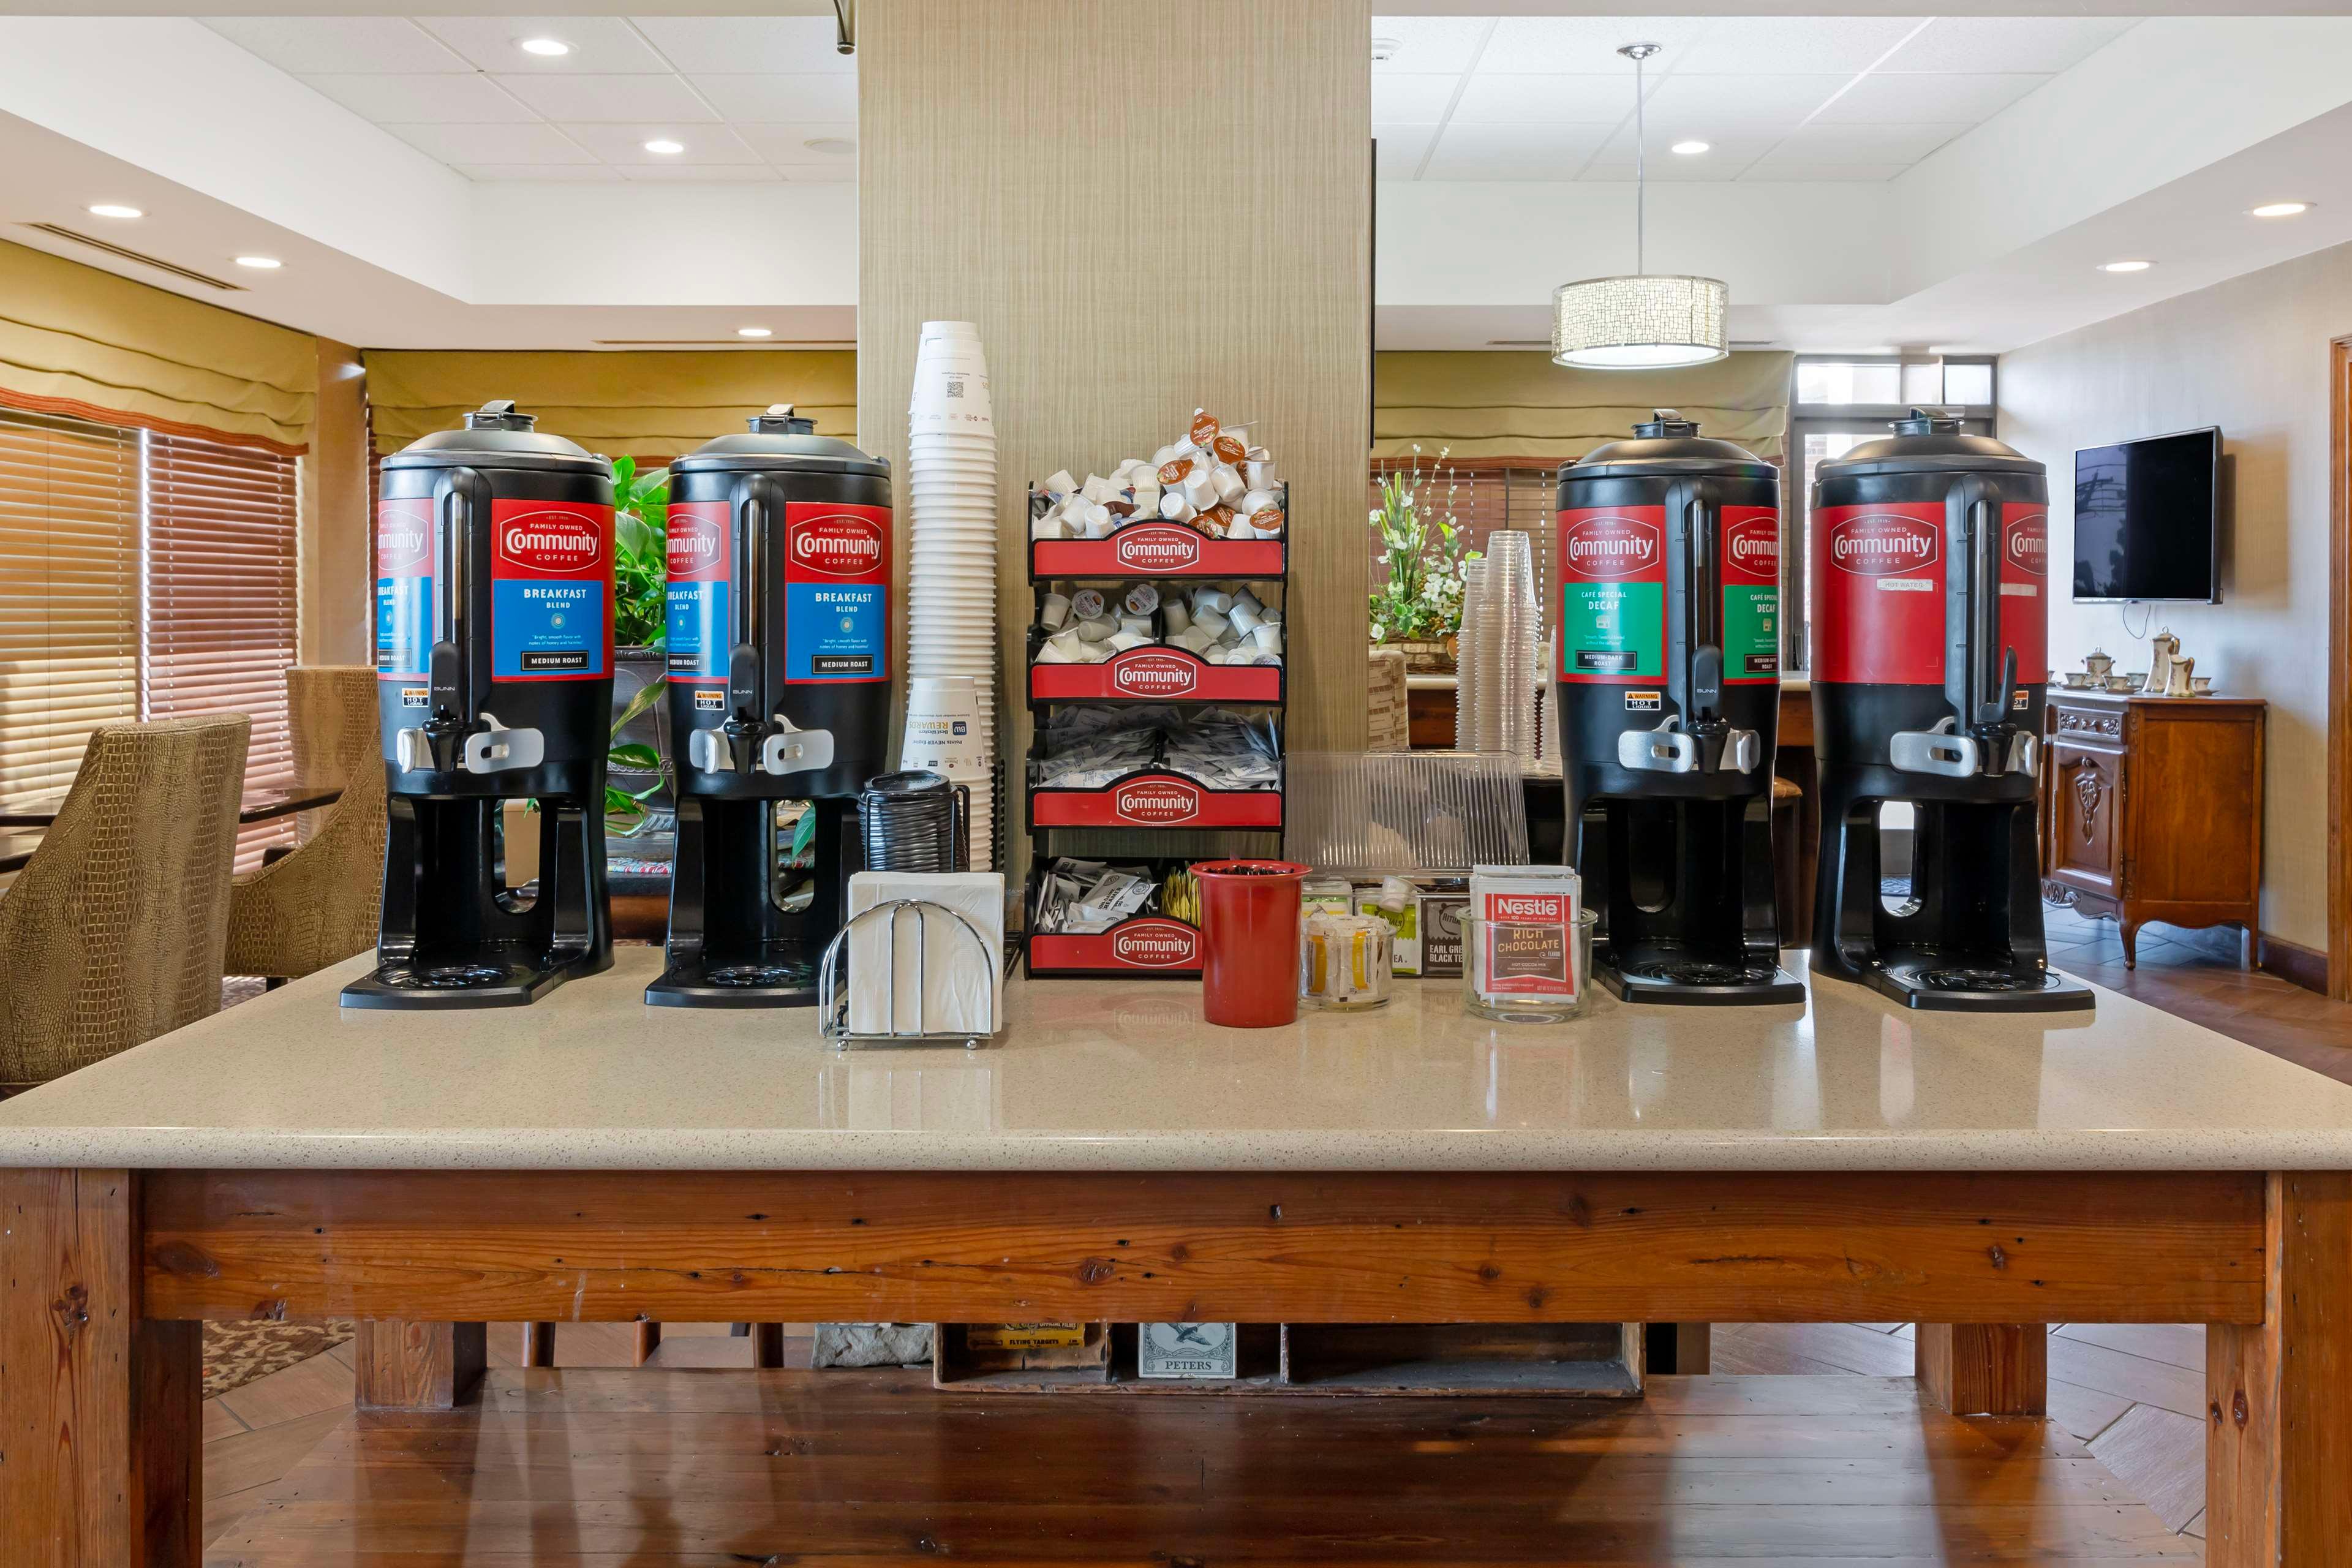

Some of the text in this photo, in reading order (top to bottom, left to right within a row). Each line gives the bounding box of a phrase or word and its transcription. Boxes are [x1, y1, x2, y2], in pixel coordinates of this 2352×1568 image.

[507, 528, 597, 556] Community
[797, 532, 880, 559] Community
[1570, 535, 1653, 561] Community
[1835, 532, 1931, 559] Community
[1122, 541, 1194, 559] Community
[524, 589, 586, 598] BREAKFAST
[815, 593, 872, 603] BREAKFAST
[1588, 601, 1619, 609] DECAF
[1757, 604, 1775, 612] DECAF
[1119, 668, 1191, 685] Community
[1121, 794, 1194, 812] Community
[1498, 899, 1558, 916] Nestlé
[1513, 929, 1544, 939] RICH
[1118, 937, 1191, 955] Community
[1430, 944, 1462, 954] EARL GRE
[1498, 940, 1559, 952] CHOCOLATE
[1430, 954, 1453, 962] BLACK
[1165, 1361, 1212, 1370] PETERS
